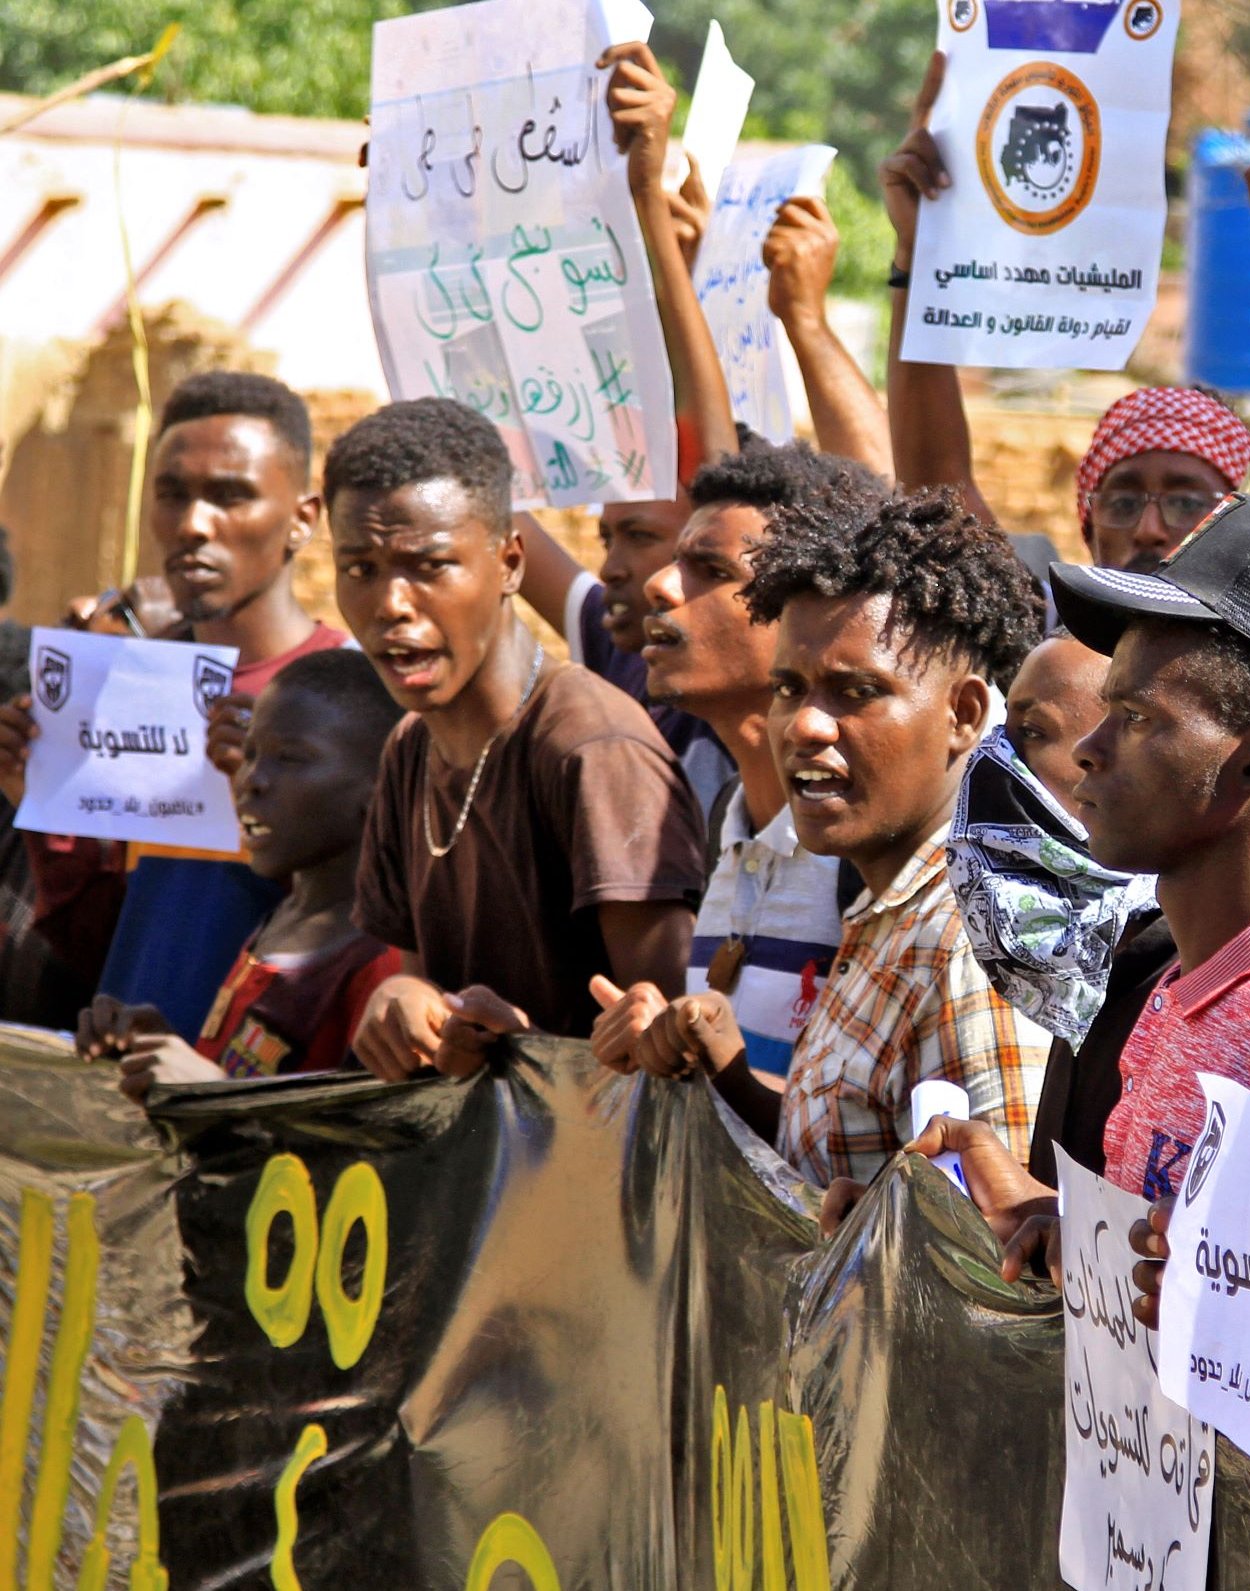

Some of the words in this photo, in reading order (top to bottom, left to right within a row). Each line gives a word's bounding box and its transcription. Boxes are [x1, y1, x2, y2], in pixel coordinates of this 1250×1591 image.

[934, 260, 997, 288] اساسي
[1004, 266, 1050, 284] مهدد
[1056, 263, 1143, 292] المليشيات
[923, 306, 982, 328] العدالة
[987, 317, 996, 334] و
[1001, 313, 1054, 336] القانون
[1057, 315, 1089, 335] دولة
[1090, 319, 1131, 340] لقيام
[79, 721, 166, 758] للتسوية
[173, 728, 189, 756] لا
